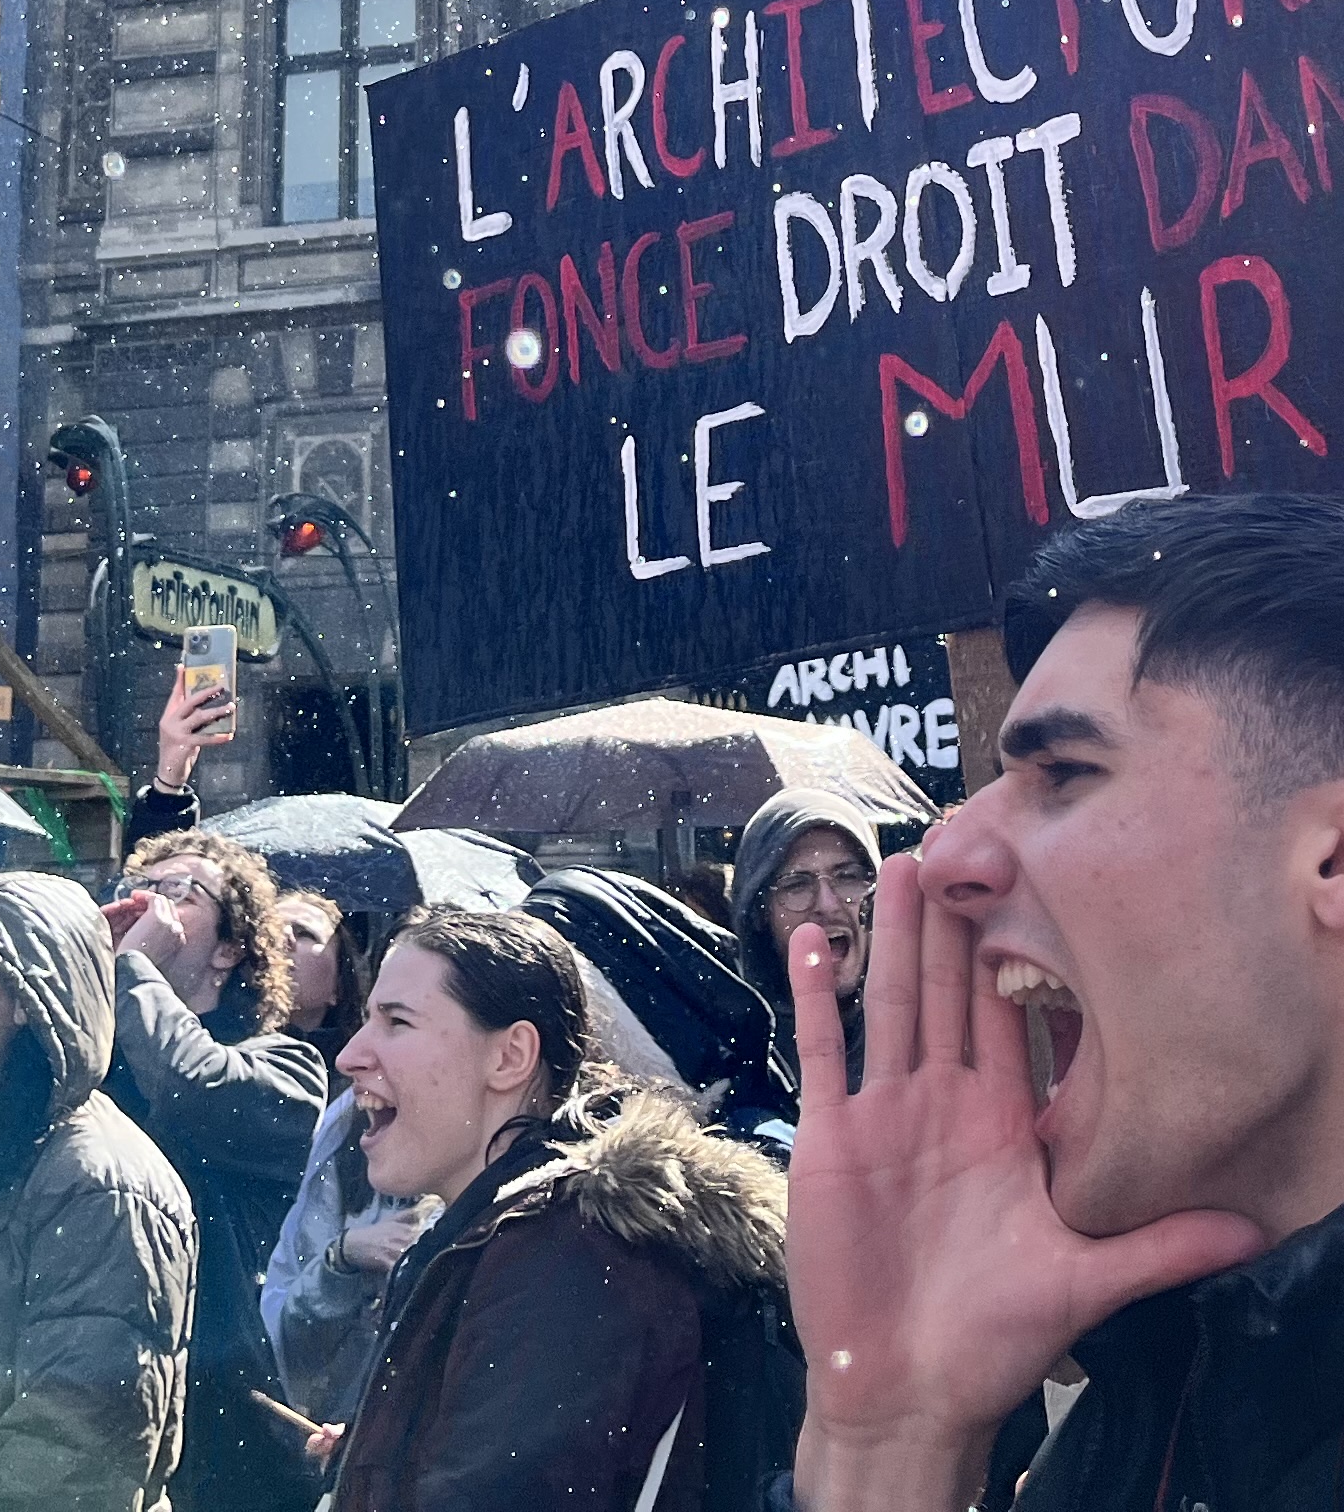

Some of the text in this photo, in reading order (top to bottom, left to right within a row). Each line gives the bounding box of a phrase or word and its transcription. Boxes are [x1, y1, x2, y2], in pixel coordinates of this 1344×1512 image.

[456, 212, 749, 421] FONCE
[775, 113, 1082, 343] DROIT
[621, 254, 1328, 580] LE MUR
[767, 644, 912, 708] ARCHI
[808, 697, 960, 769] VRE
